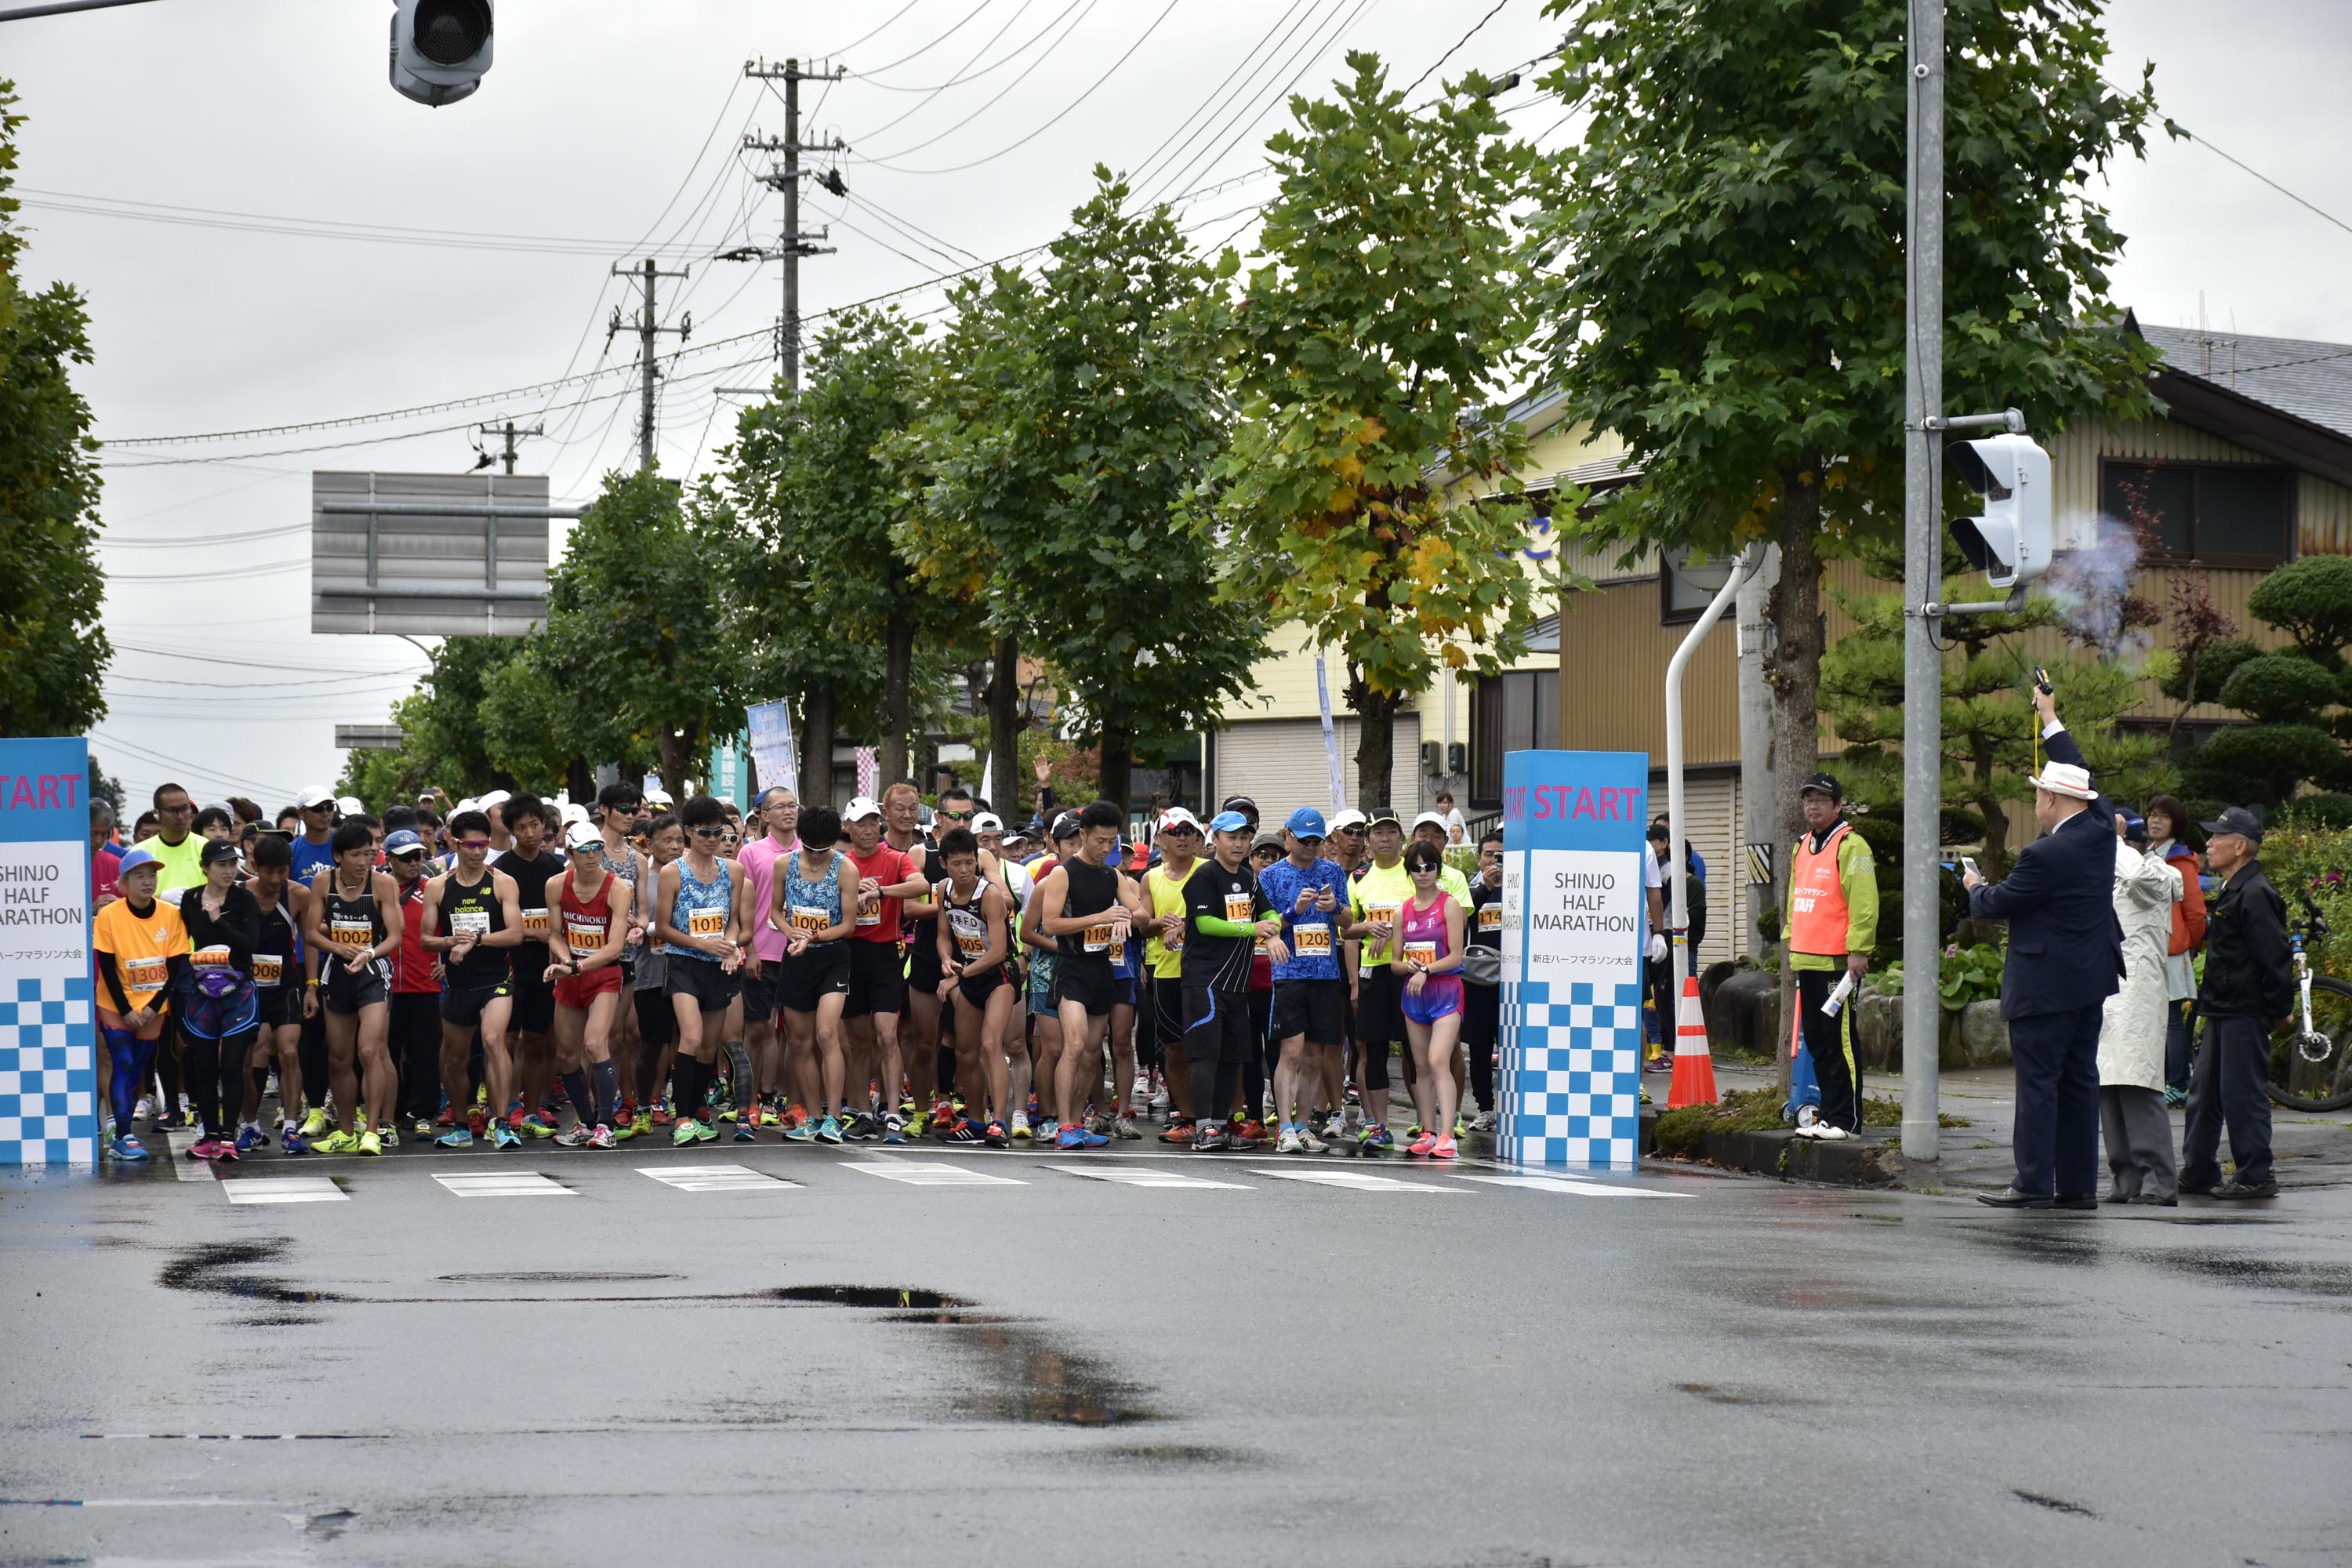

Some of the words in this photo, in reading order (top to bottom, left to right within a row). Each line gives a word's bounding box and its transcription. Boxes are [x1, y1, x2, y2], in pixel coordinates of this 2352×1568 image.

[1534, 785, 1641, 821] START
[1555, 873, 1615, 890] SHINJO
[5, 887, 49, 904] HALF
[1563, 895, 1605, 910] HALF
[1794, 898, 1815, 913] STAFF
[564, 911, 608, 925] MICHINOKU
[691, 916, 723, 931] 1013
[794, 916, 829, 931] 1006
[1534, 914, 1634, 932] MARATHON
[333, 931, 370, 943] 1002
[570, 932, 602, 947] 1101
[1087, 927, 1112, 942] 1104
[1296, 933, 1330, 946] 1205
[194, 953, 228, 965] 1410
[1533, 954, 1633, 966] 新庄ハーフマラソン大会
[129, 966, 167, 982] 1308
